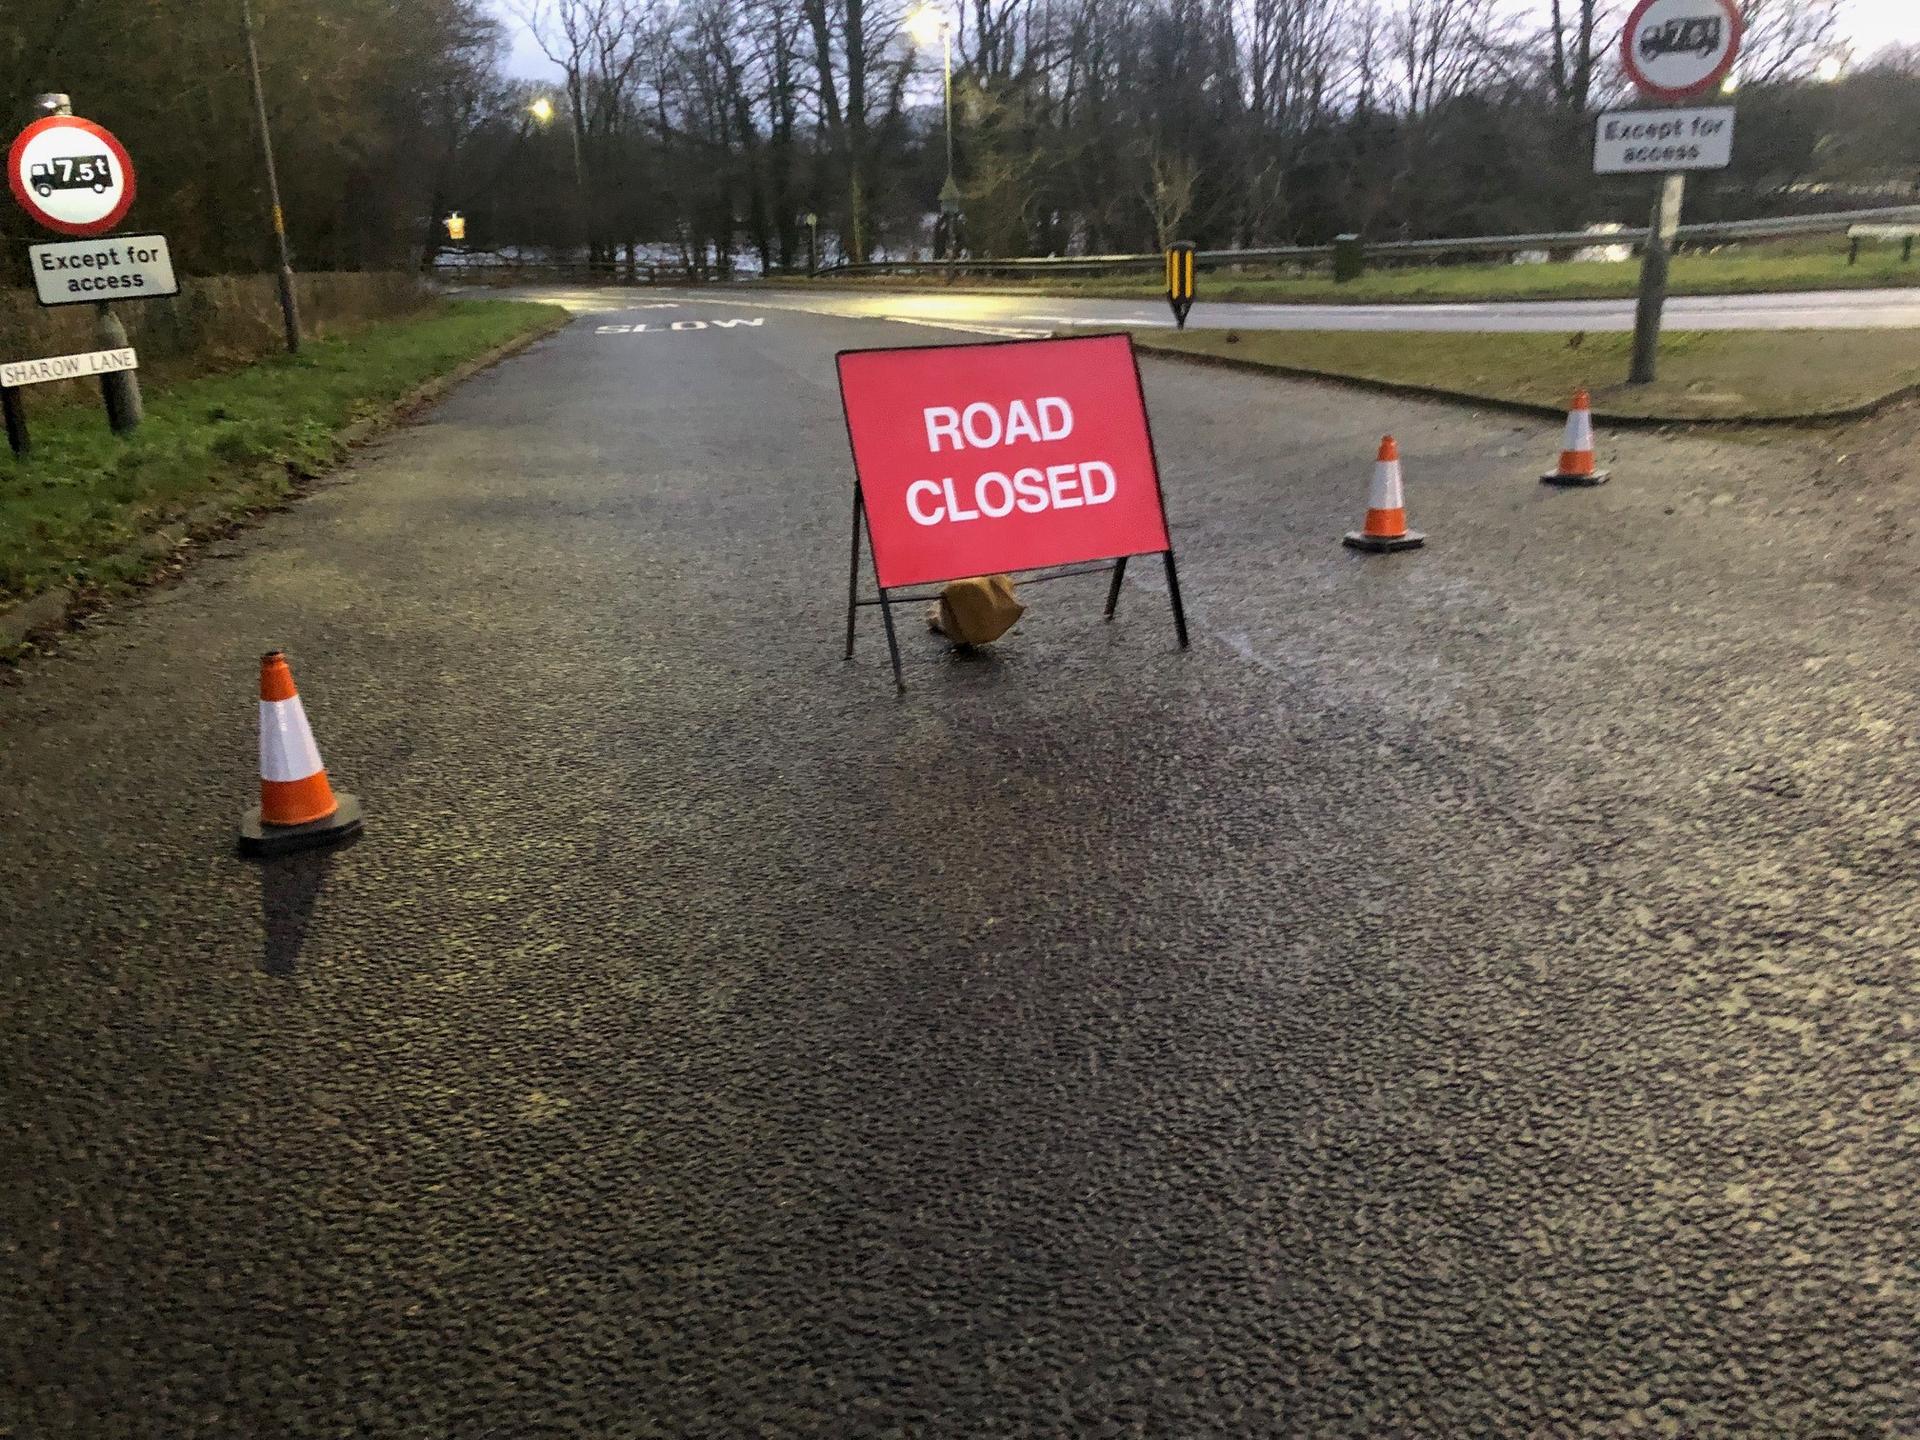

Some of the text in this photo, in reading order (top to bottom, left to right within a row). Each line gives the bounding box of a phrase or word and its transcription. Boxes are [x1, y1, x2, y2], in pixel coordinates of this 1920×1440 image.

[1605, 116, 1726, 141] Except for
[1623, 143, 1700, 164] access
[40, 246, 159, 271] Except for
[68, 272, 144, 292] access
[595, 317, 766, 334] SLOW
[5, 350, 134, 384] SHAROW LANE
[923, 396, 1074, 452] ROAD
[905, 460, 1117, 527] CLOSED
